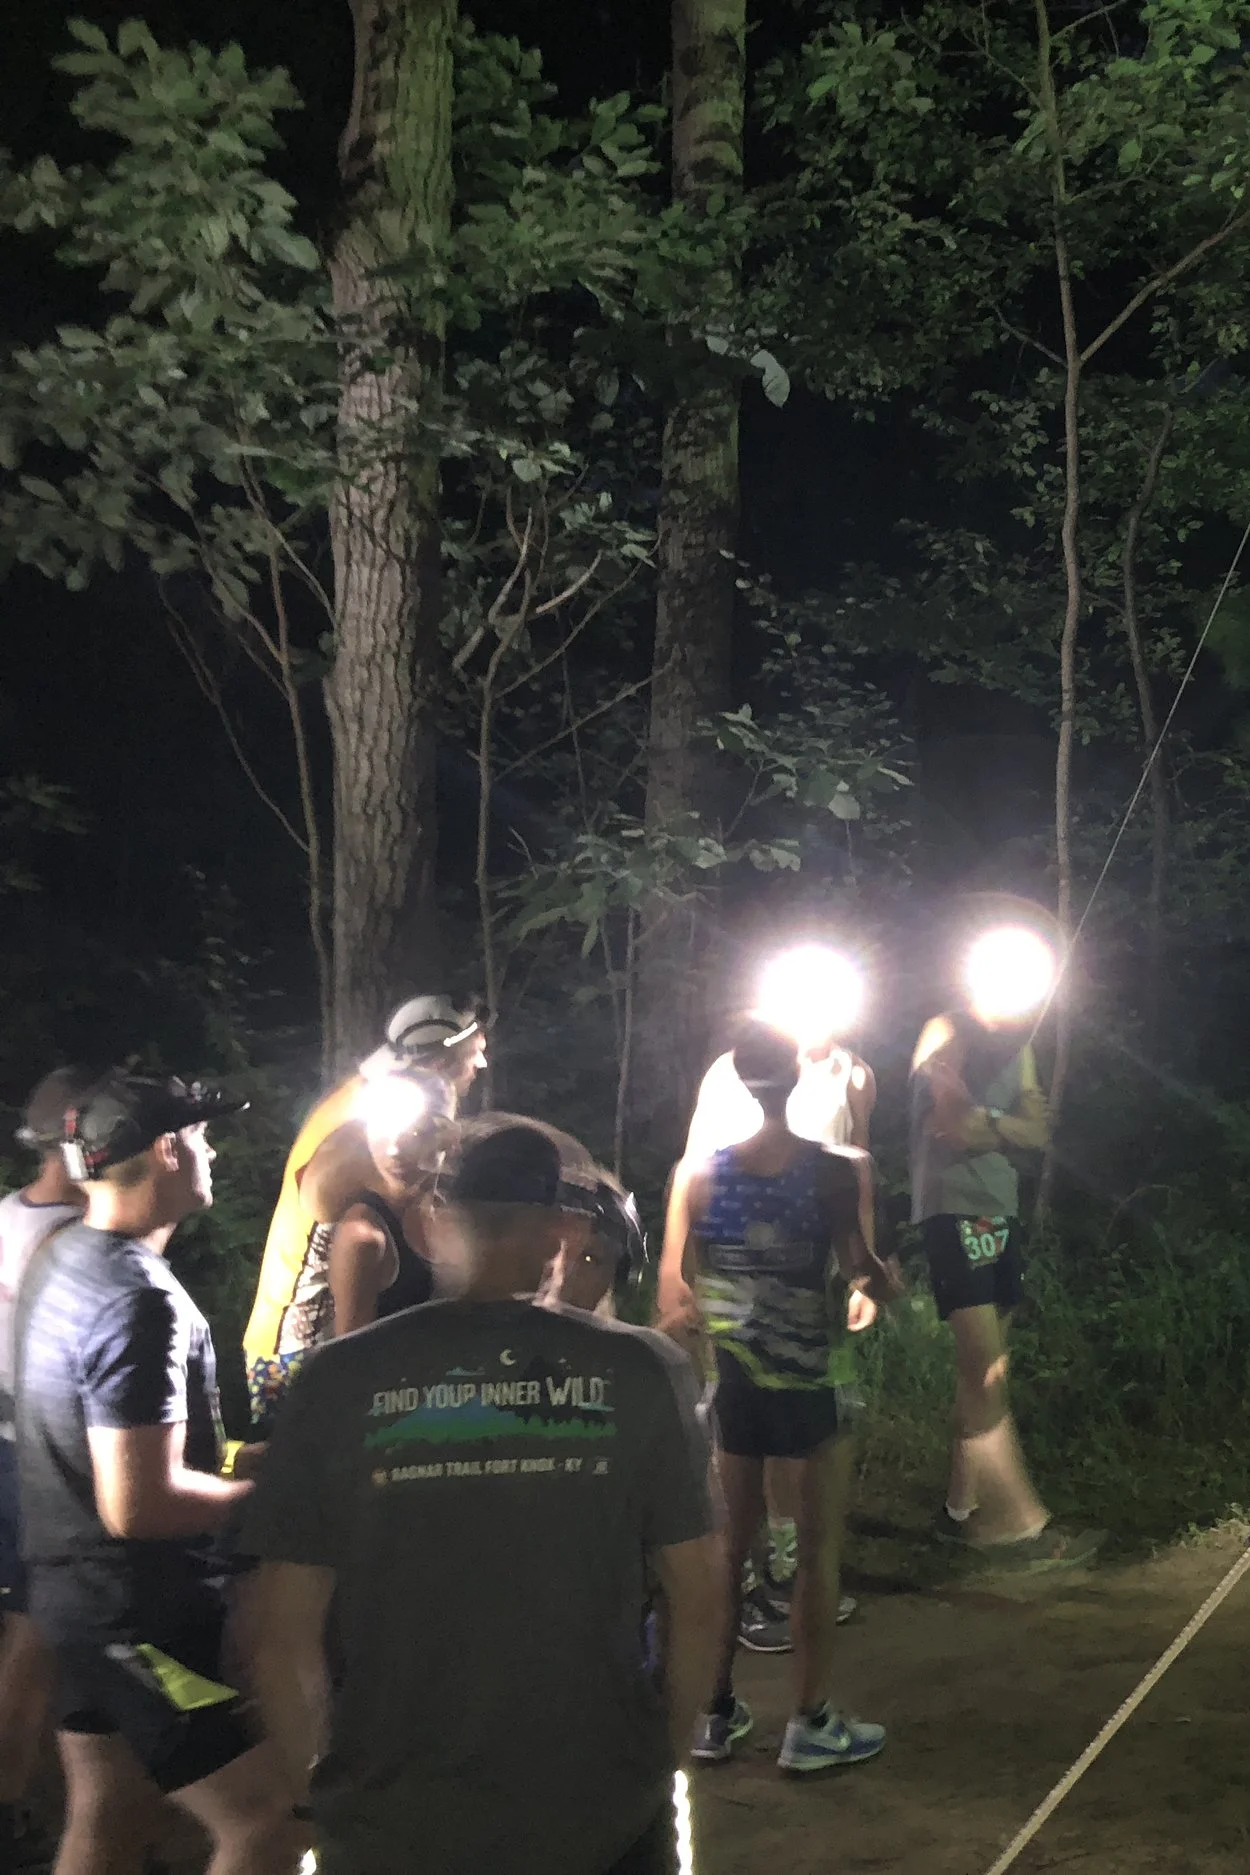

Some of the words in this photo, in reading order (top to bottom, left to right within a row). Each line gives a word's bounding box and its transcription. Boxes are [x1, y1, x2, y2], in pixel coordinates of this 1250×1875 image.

[964, 1228, 1009, 1260] 307
[372, 1387, 420, 1416] FIND
[481, 1380, 541, 1407] INNER
[546, 1376, 606, 1406] WILD
